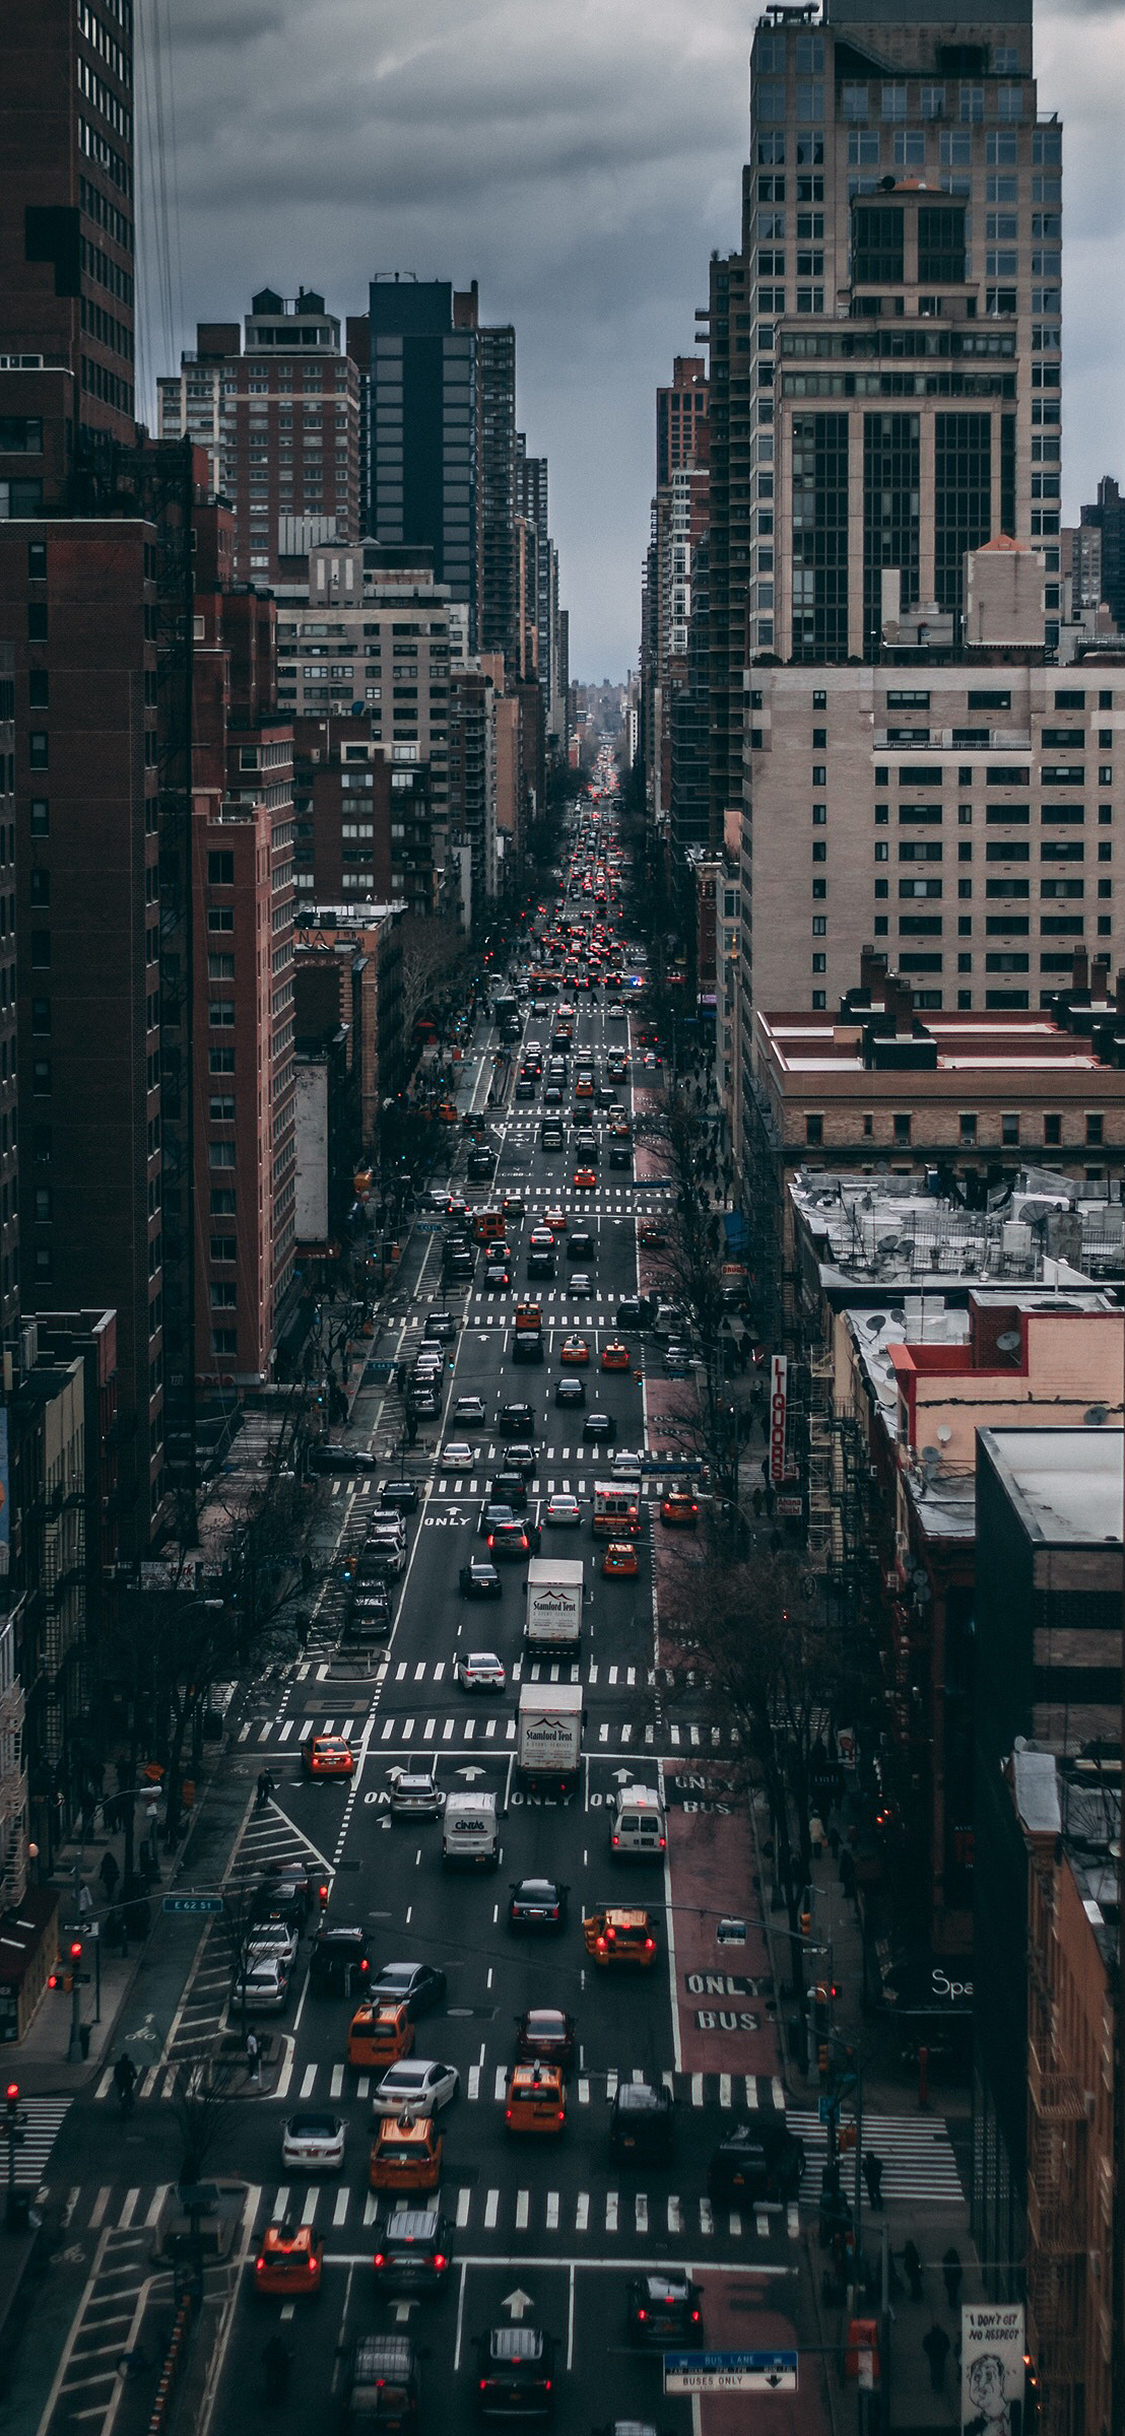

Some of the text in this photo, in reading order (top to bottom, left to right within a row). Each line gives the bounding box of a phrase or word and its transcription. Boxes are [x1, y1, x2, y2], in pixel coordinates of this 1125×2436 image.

[771, 1358, 785, 1479] LIQUORS
[424, 1517, 471, 1526] ONLY
[533, 1601, 576, 1611] Stamford Tent
[526, 1729, 572, 1741] Stamford Tent
[675, 1776, 738, 1791] ONLY
[364, 1791, 391, 1803] ON
[511, 1792, 575, 1806] ONLY
[590, 1793, 616, 1806] ON
[683, 1800, 732, 1814] BUS
[174, 1901, 211, 1909] E 62 St
[688, 1974, 764, 1996] ONLY
[698, 2010, 758, 2031] BUS
[977, 2312, 1001, 2327] DON'T
[1003, 2314, 1018, 2326] GET
[969, 2328, 1019, 2340] NO RESPECT
[705, 2355, 755, 2366] BUS LANE
[683, 2376, 743, 2386] BUSES ONLY
